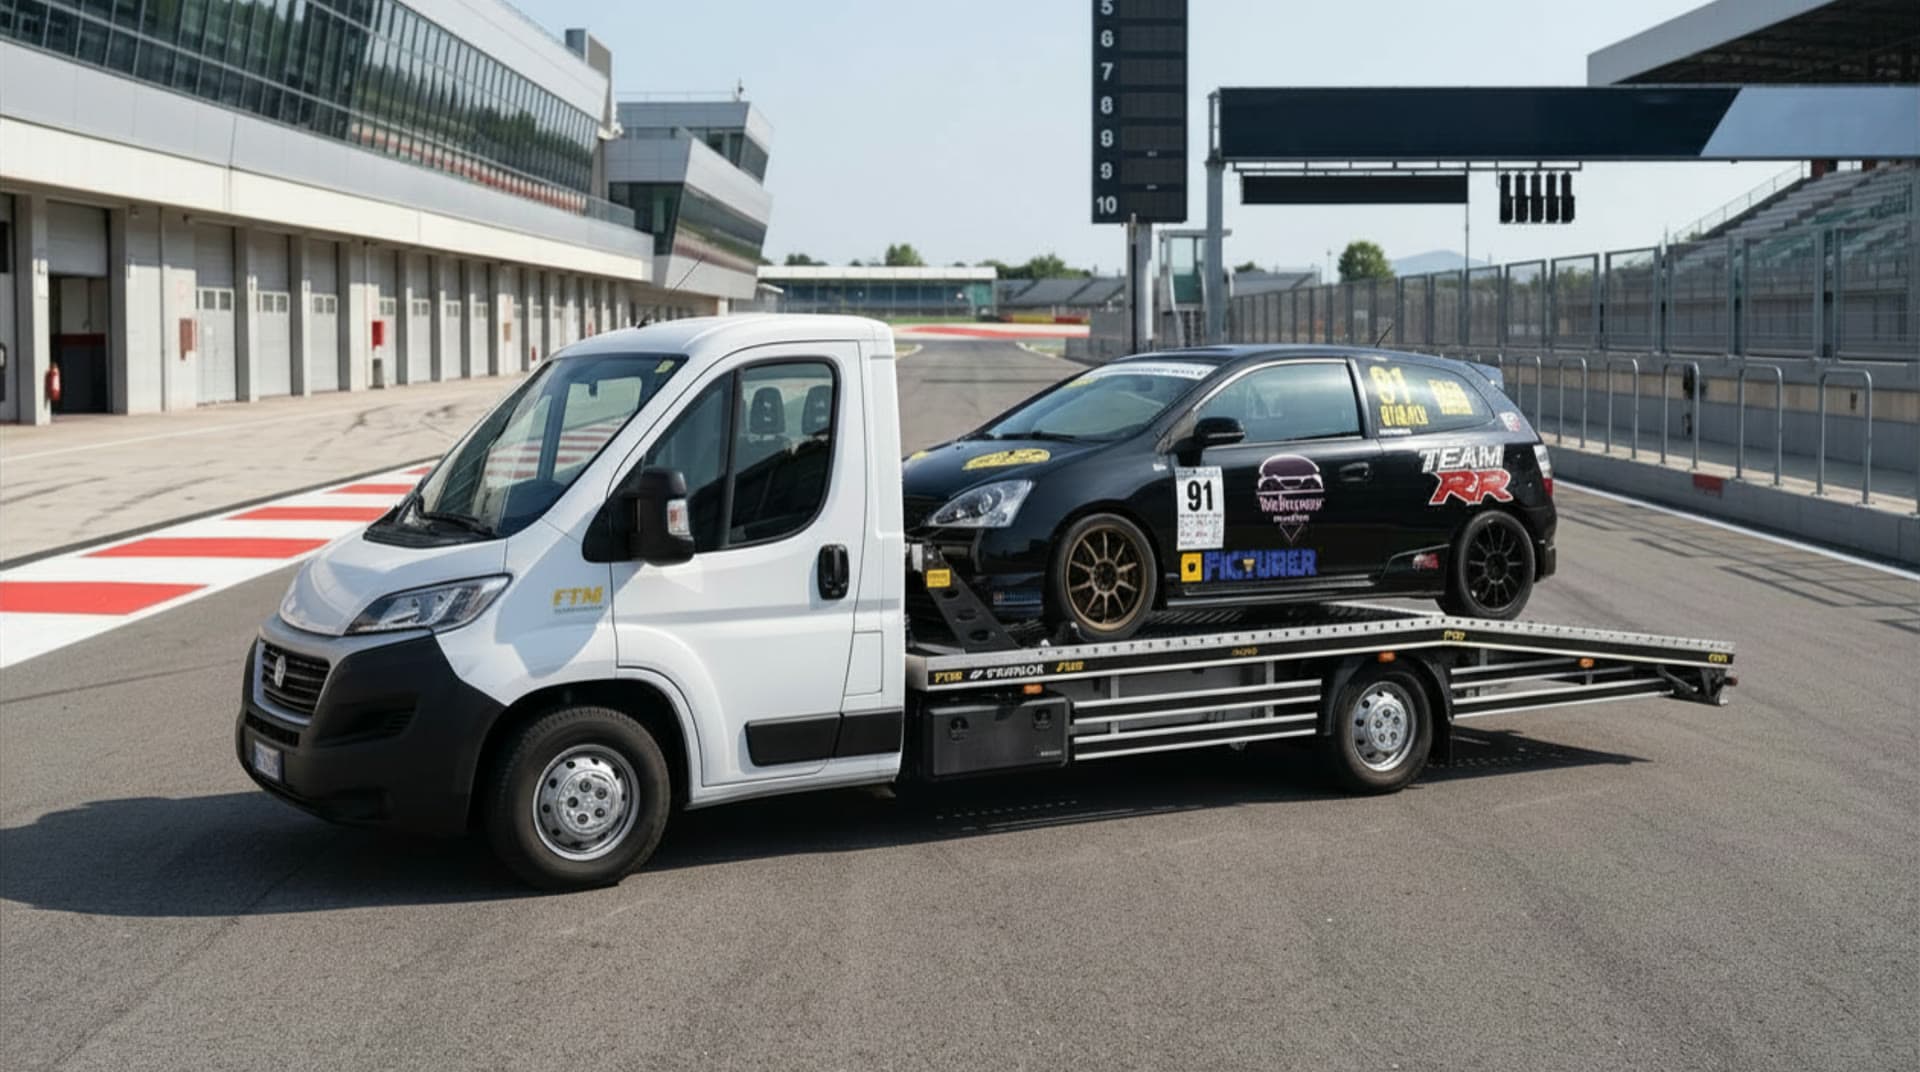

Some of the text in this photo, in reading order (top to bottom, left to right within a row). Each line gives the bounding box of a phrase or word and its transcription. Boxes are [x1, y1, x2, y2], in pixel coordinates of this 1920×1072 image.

[1101, 62, 1113, 80] 7
[1101, 130, 1113, 147] 8
[1096, 196, 1117, 214] 10
[1418, 444, 1505, 473] TEAM
[1187, 480, 1213, 512] 91
[1429, 468, 1514, 506] RR
